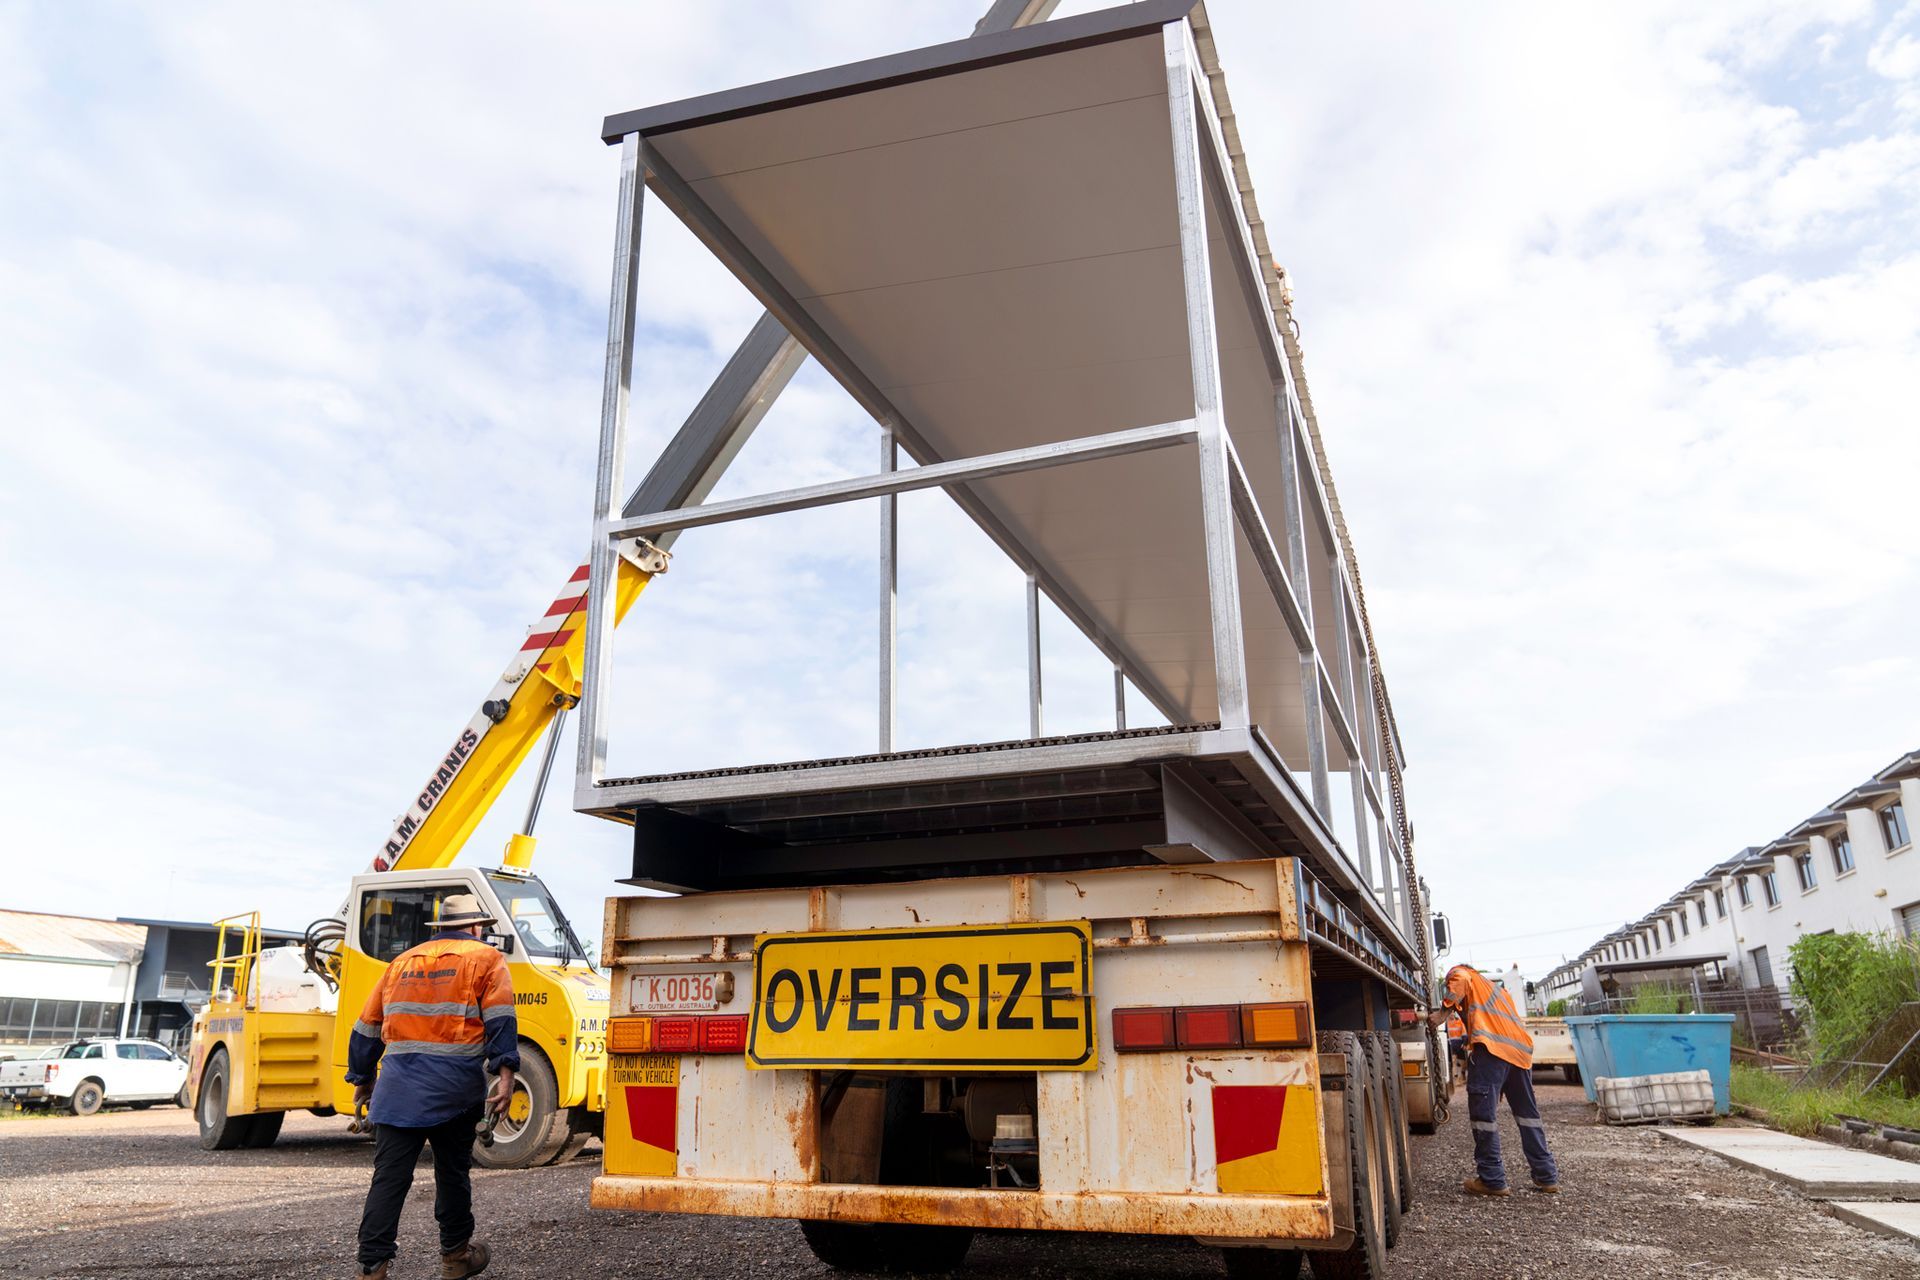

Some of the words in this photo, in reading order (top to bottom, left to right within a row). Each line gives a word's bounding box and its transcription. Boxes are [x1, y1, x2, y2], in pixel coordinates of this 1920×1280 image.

[385, 815, 421, 860] A.M.
[417, 729, 478, 812] CRANES
[764, 961, 1079, 1034] OVERSIZE
[580, 1018, 599, 1032] A.M.
[613, 1056, 623, 1069] DO
[625, 1056, 638, 1069] NOT
[640, 1055, 675, 1069] OVERTAKE
[613, 1070, 642, 1084] TURNING
[645, 1070, 673, 1083] VEHICLE
